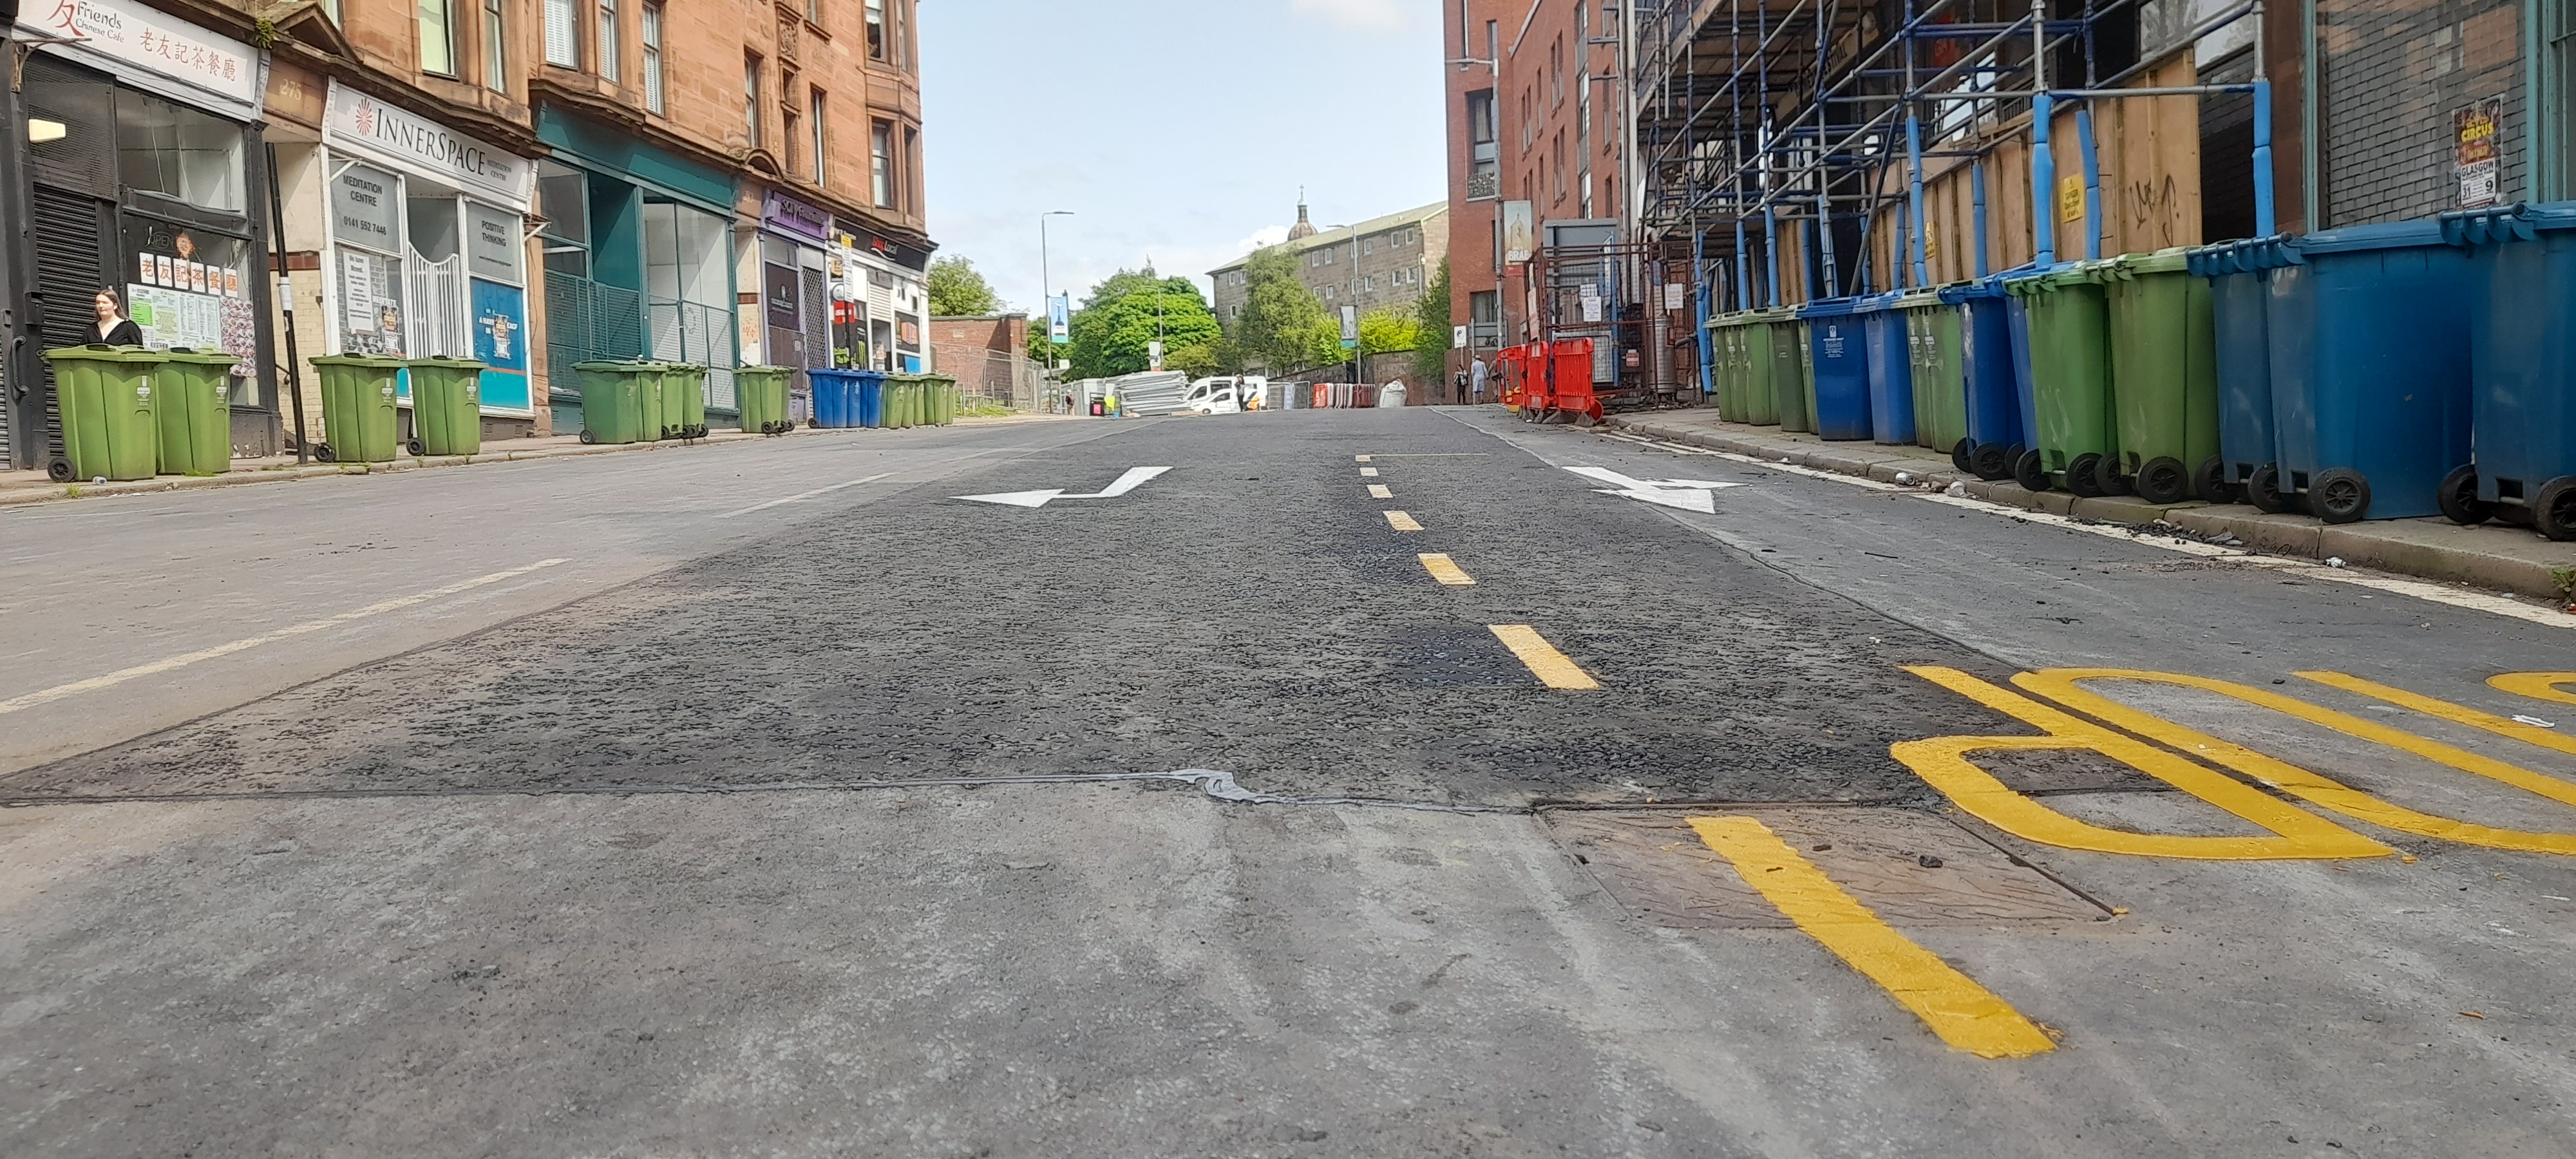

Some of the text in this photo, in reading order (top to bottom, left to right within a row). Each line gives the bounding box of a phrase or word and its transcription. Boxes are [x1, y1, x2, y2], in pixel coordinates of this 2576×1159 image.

[77, 1, 122, 30] Friends
[75, 18, 124, 43] Chinese Cafe
[139, 27, 236, 82] 老友記茶餐廳
[280, 78, 302, 100] 275
[2461, 122, 2494, 142] CIRCUS
[2461, 161, 2494, 177] GLASGOW
[343, 174, 383, 194] MEDITATION
[2463, 186, 2471, 198] 31
[2486, 180, 2494, 191] 9
[350, 191, 377, 207] CENTRE
[343, 216, 358, 228] 0141
[360, 220, 371, 231] 552
[482, 220, 505, 235] POSITIVE
[141, 258, 238, 292] 老友記茶餐廳
